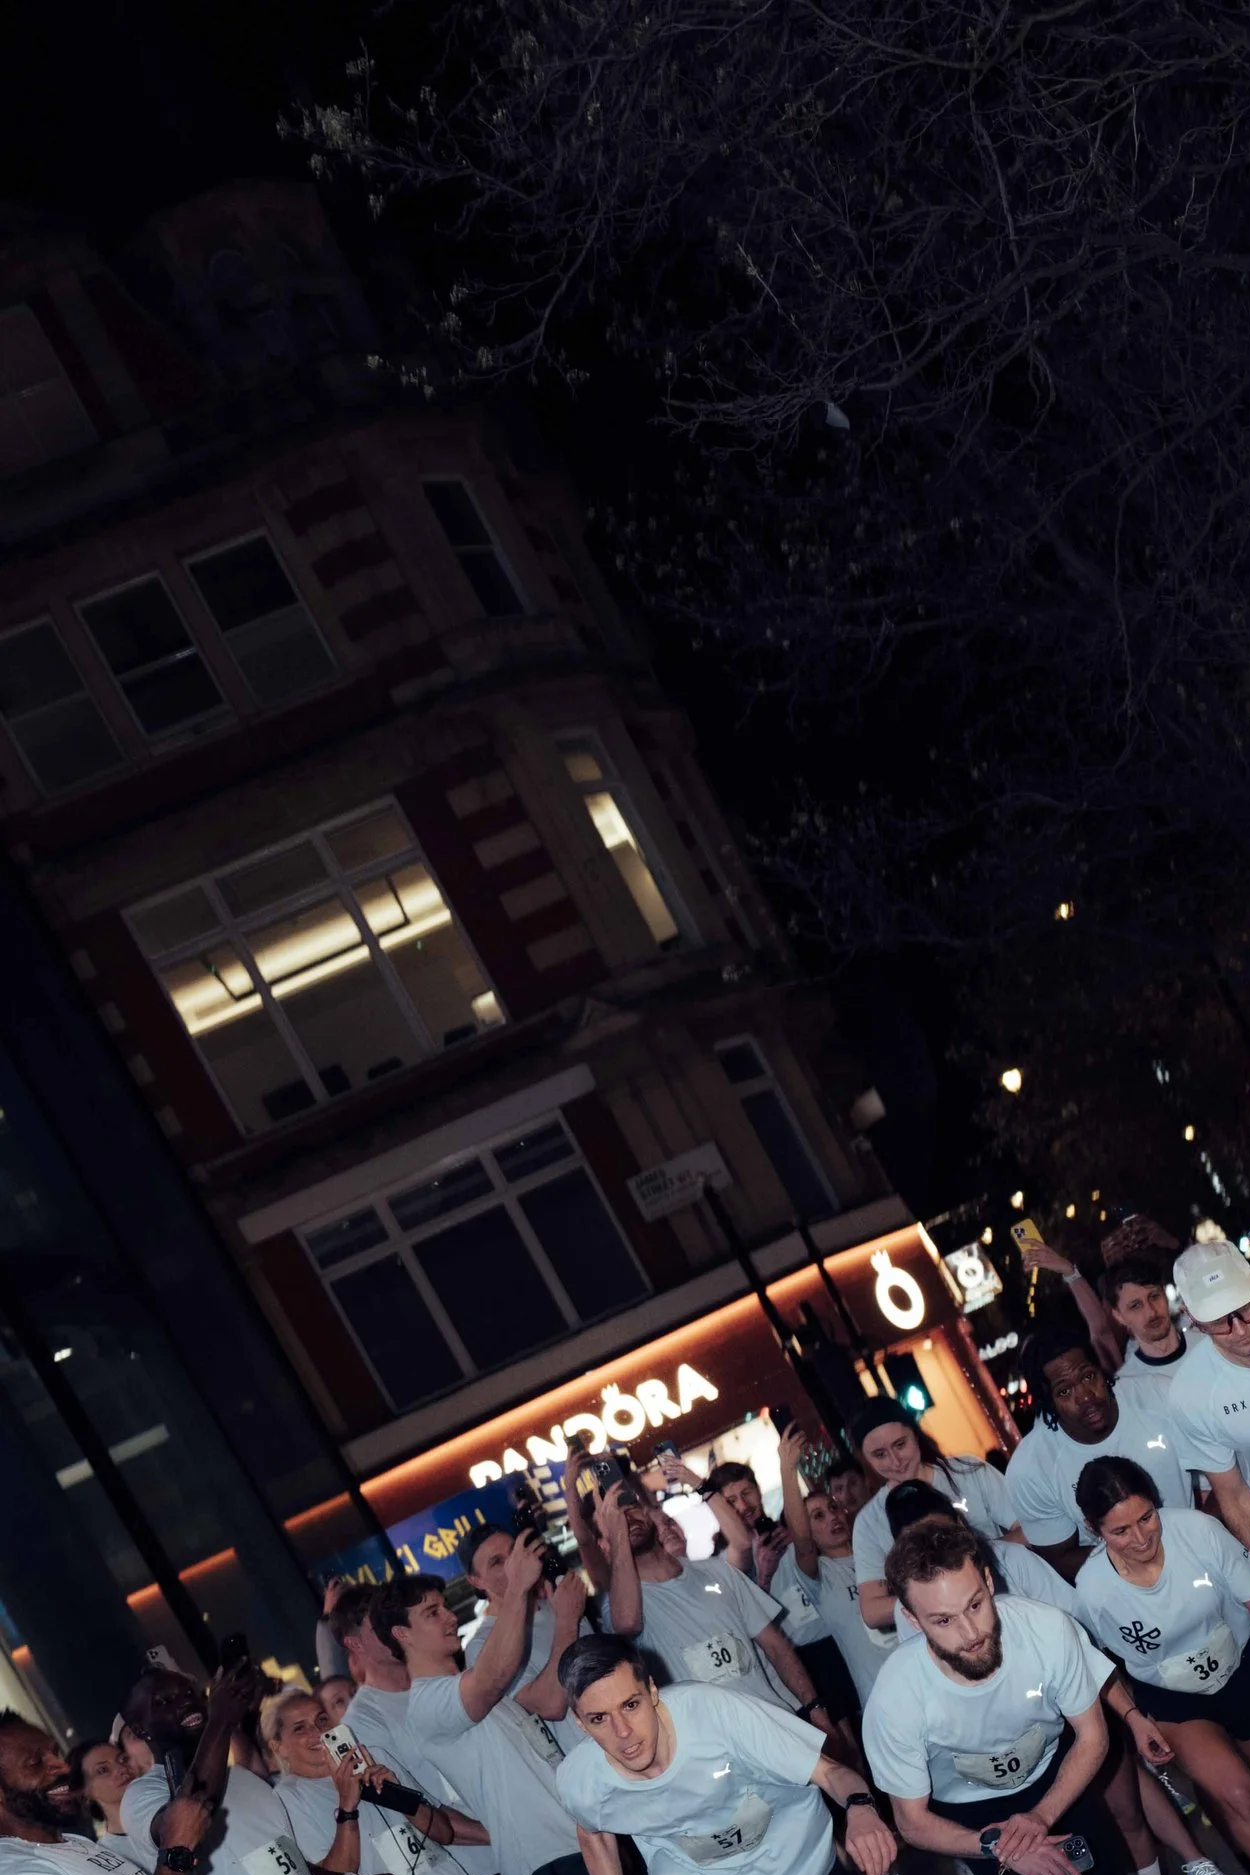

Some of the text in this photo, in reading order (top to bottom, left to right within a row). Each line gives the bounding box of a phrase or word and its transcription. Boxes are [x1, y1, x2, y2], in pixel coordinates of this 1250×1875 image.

[1223, 1400, 1247, 1415] BRX
[710, 1647, 732, 1668] 30
[1193, 1656, 1219, 1681] 36
[993, 1757, 1021, 1778] 50
[717, 1828, 743, 1850] 57
[275, 1851, 298, 1875] 58
